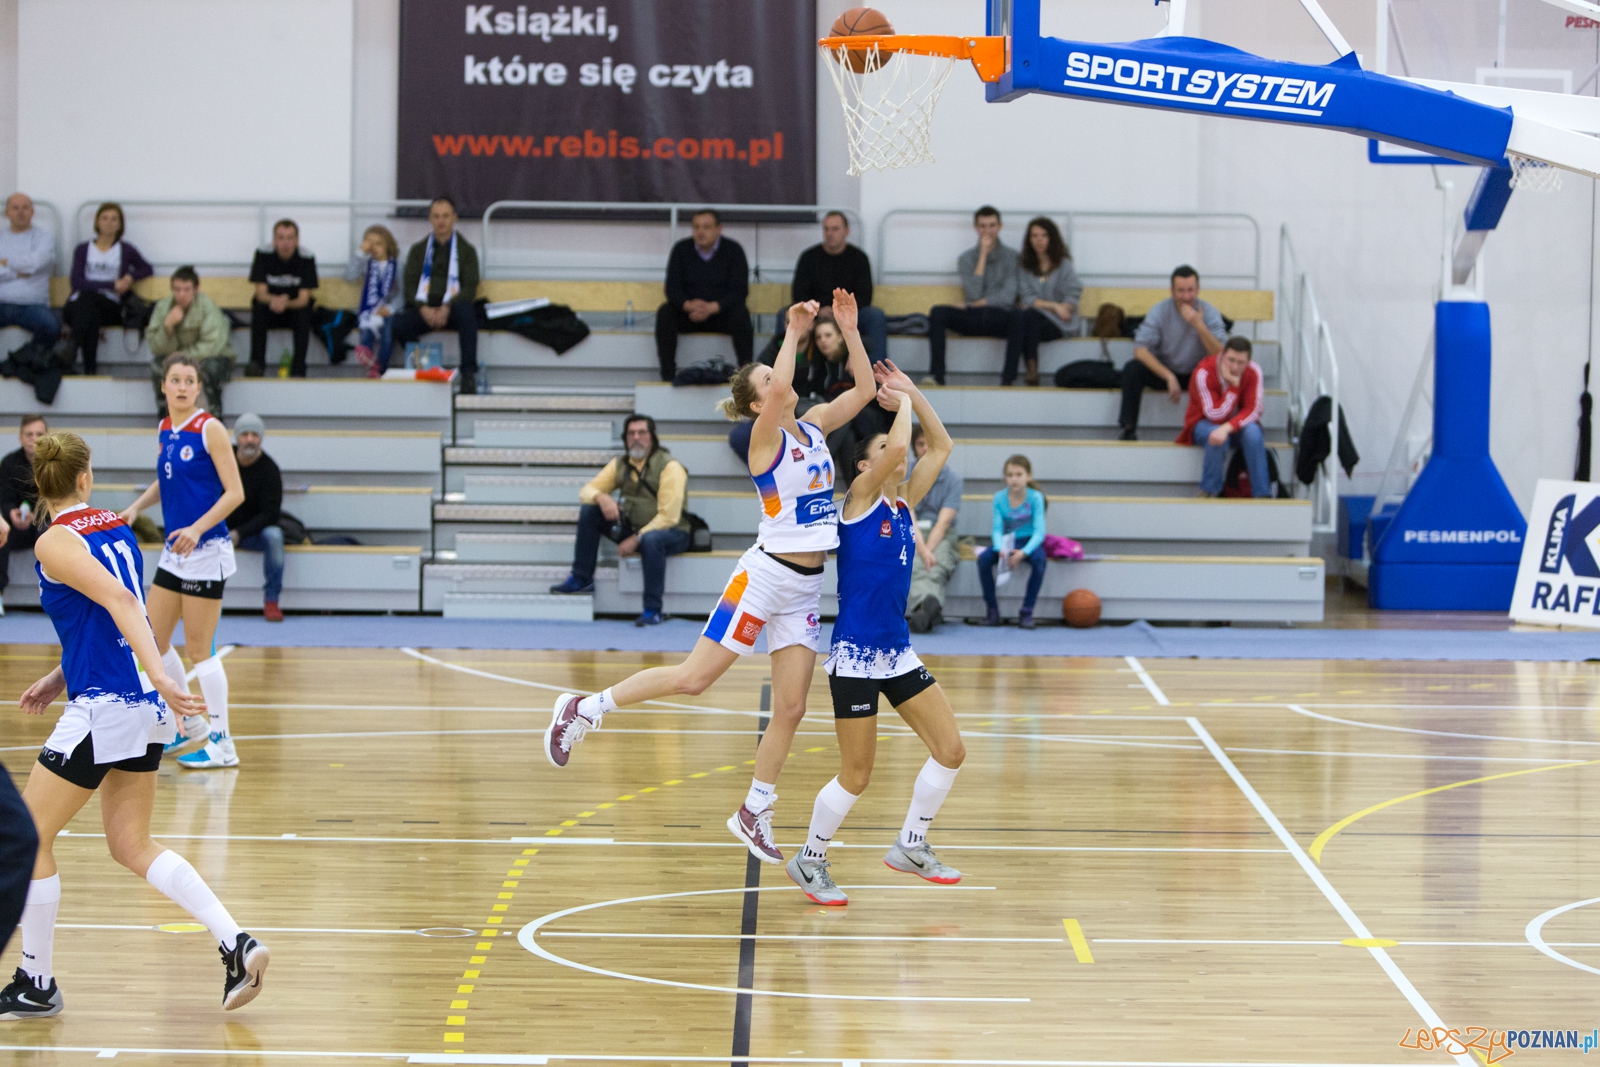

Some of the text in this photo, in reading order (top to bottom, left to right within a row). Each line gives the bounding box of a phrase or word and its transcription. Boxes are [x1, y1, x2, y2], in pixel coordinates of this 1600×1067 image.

[465, 5, 619, 42] Książki,
[464, 55, 754, 94] które się czyta
[432, 130, 783, 166] www.rebis.com.pl
[164, 461, 172, 479] 9
[807, 459, 832, 491] 21
[1404, 529, 1521, 543] PESMENPOL
[1545, 507, 1569, 569] KLIMA
[899, 545, 907, 566] 4
